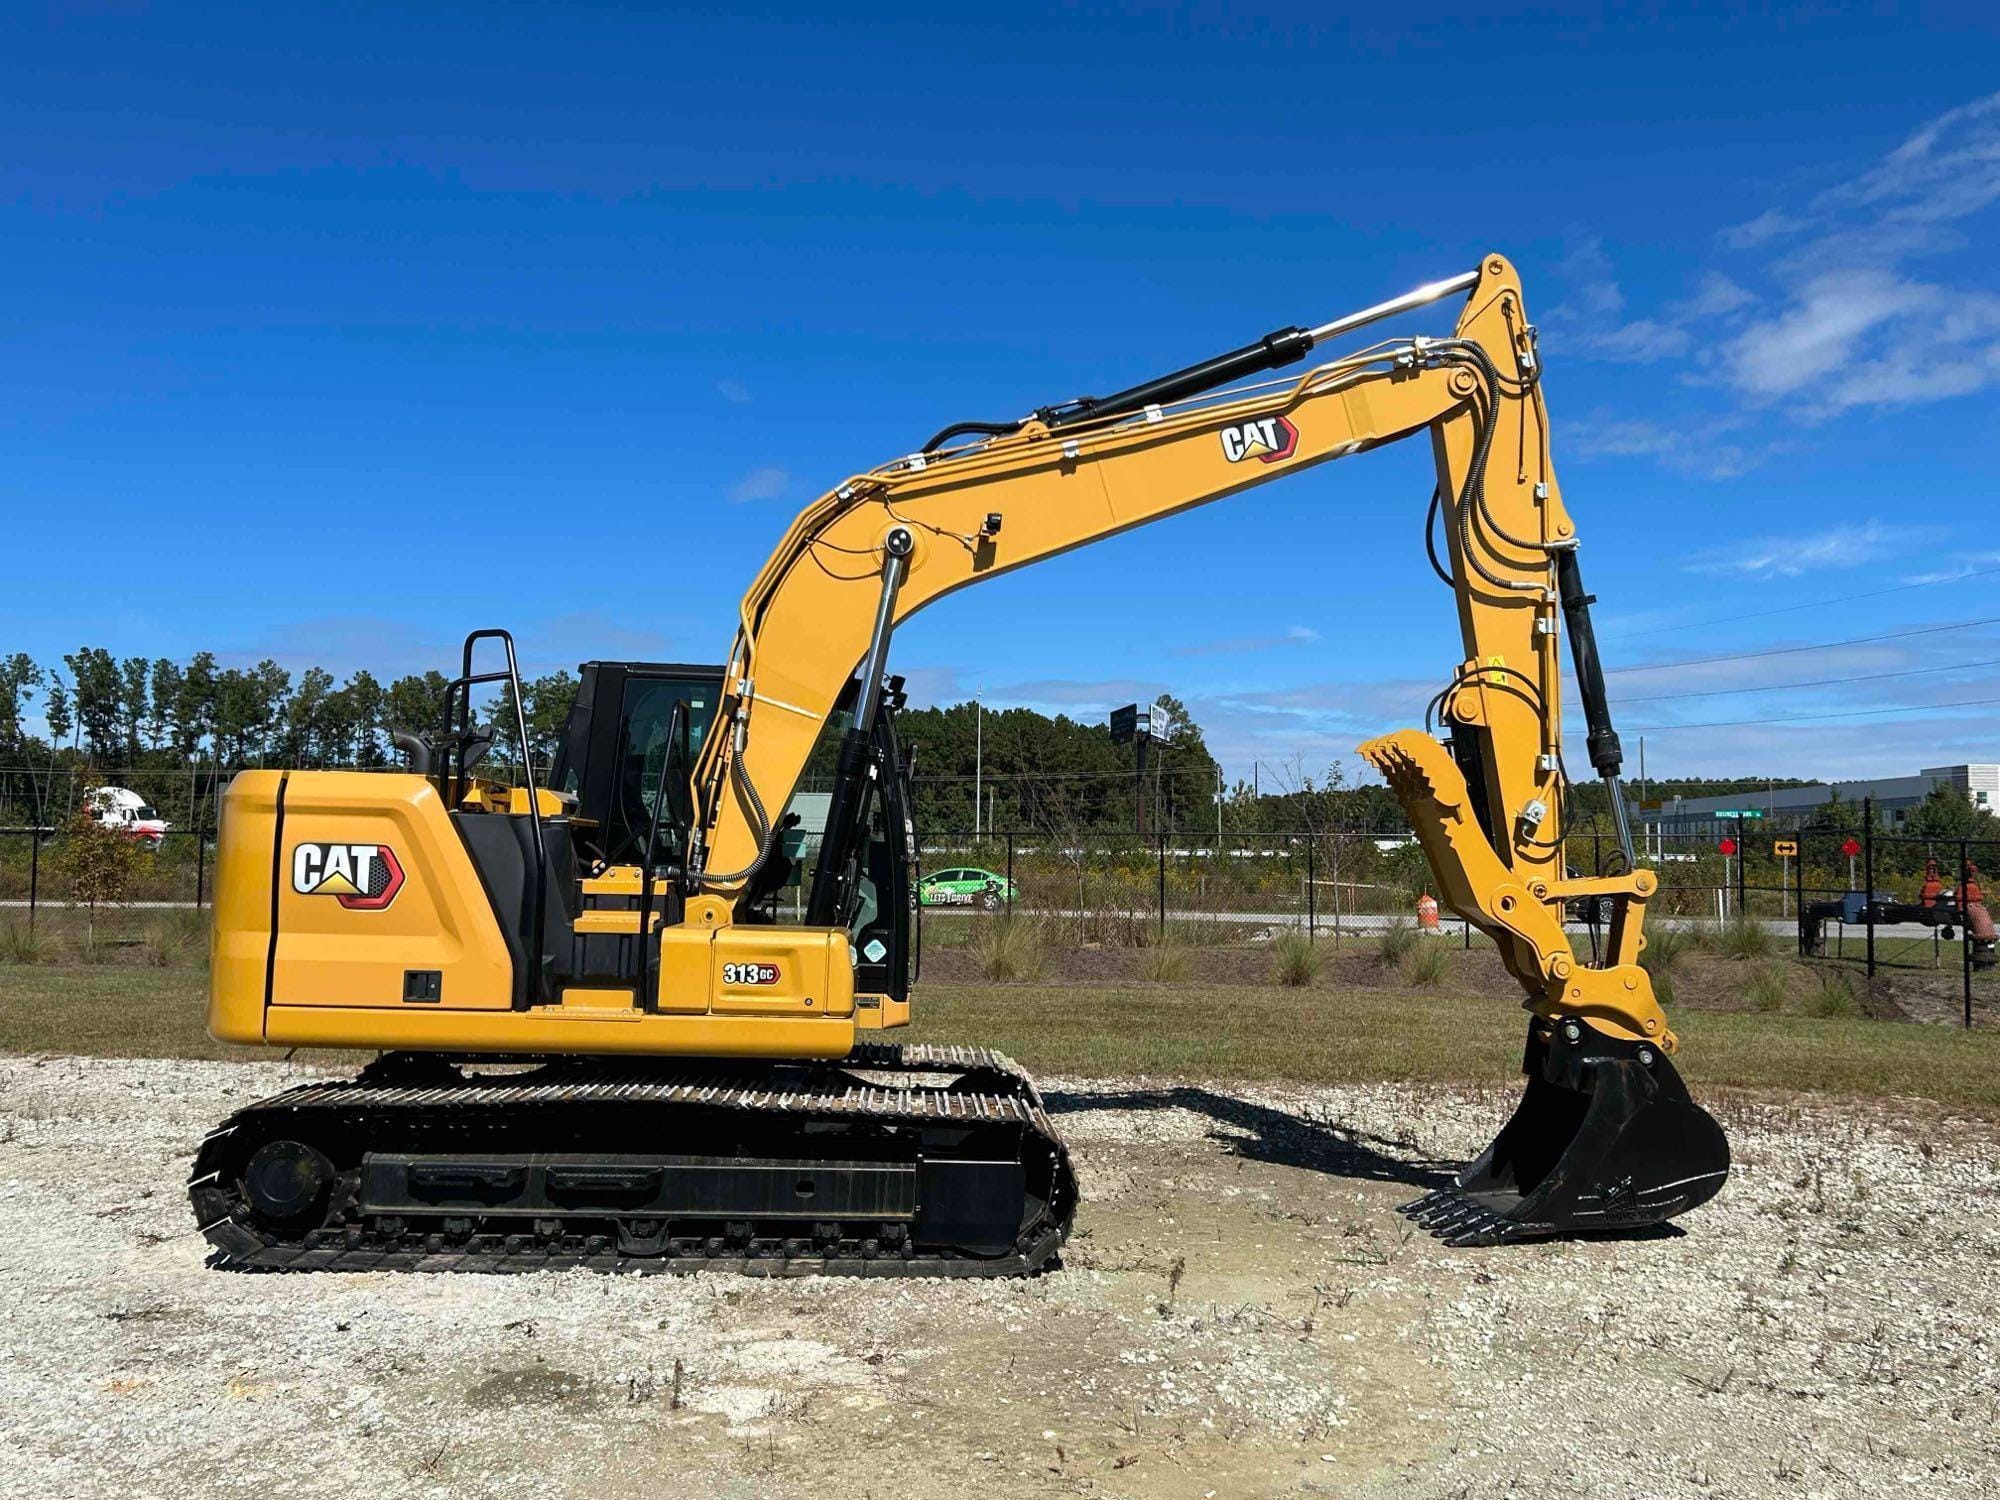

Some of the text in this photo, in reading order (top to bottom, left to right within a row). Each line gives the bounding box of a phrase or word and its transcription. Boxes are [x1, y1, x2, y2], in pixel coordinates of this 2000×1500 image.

[1221, 417, 1279, 462] CAT
[294, 844, 378, 895] CAT
[724, 964, 774, 983] 313 GC
